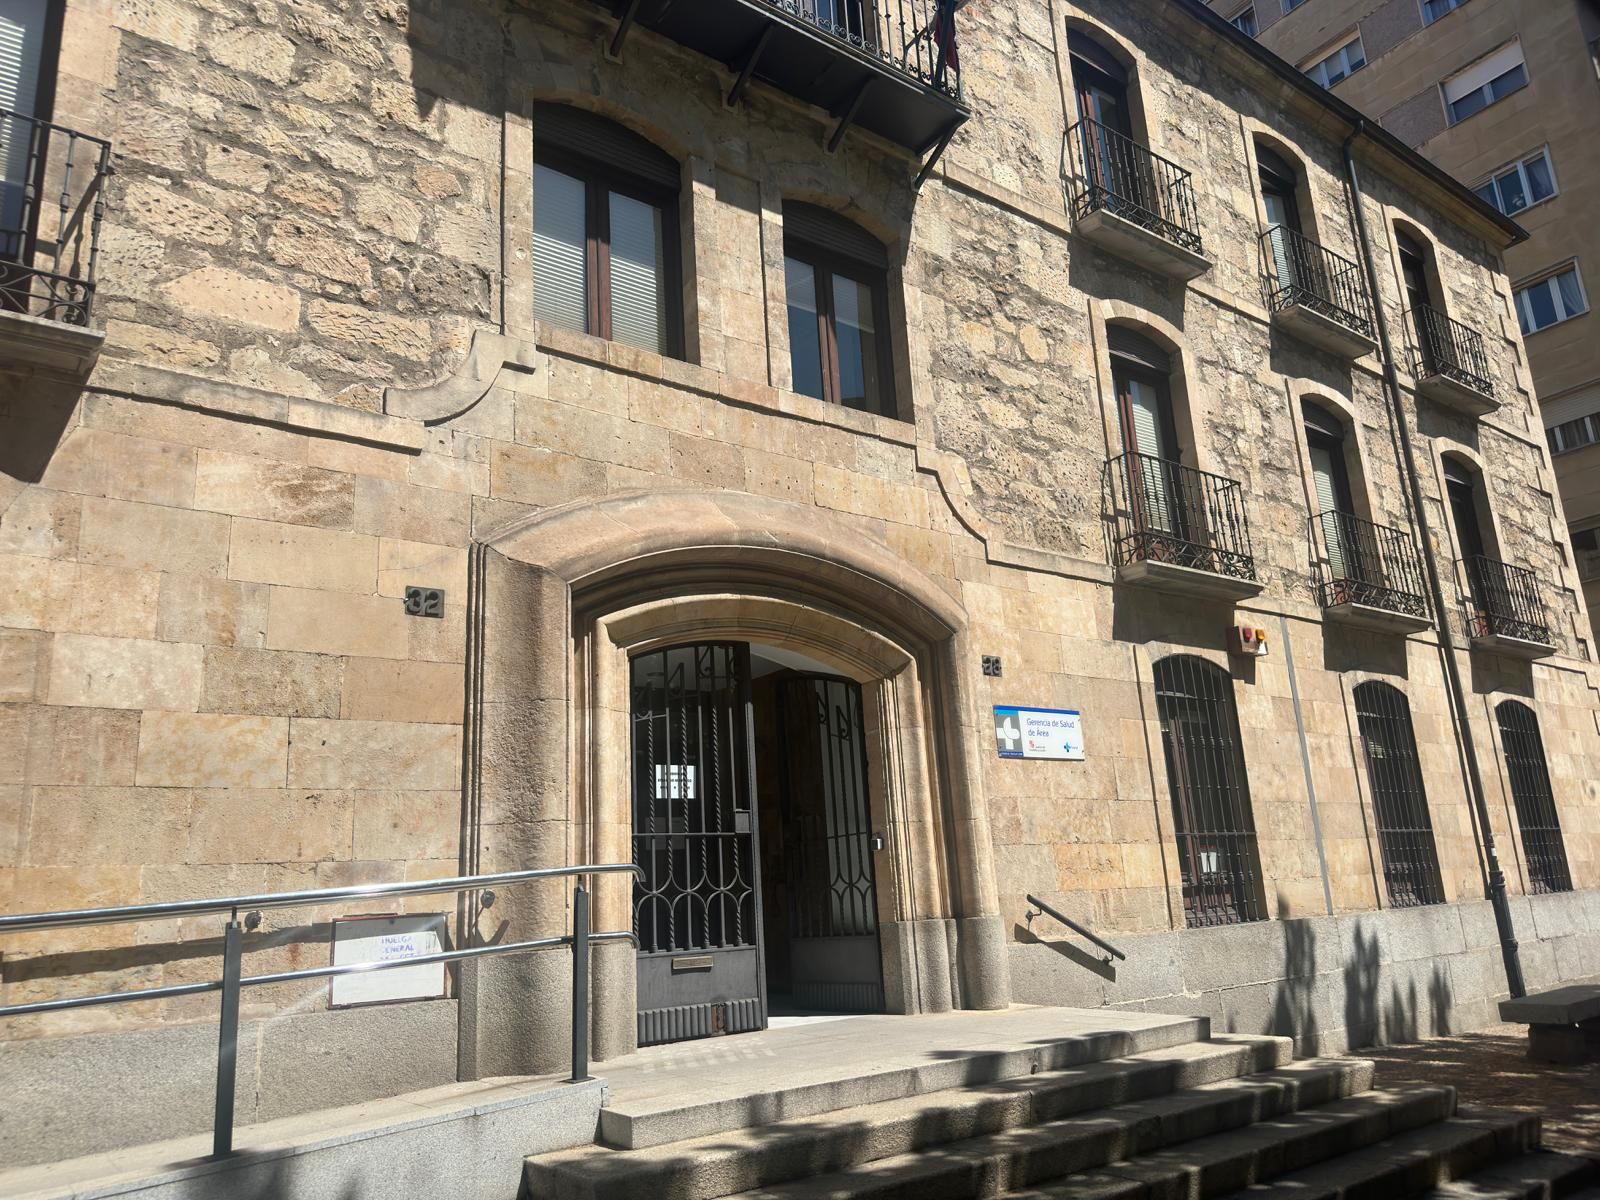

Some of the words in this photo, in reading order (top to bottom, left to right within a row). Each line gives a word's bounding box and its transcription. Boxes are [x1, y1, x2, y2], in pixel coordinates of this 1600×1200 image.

[405, 587, 440, 617] 32
[1026, 717, 1050, 727] Gerencia
[1051, 719, 1059, 728] de
[1060, 719, 1075, 729] Salud
[1028, 729, 1035, 737] de
[1036, 727, 1049, 737] Área
